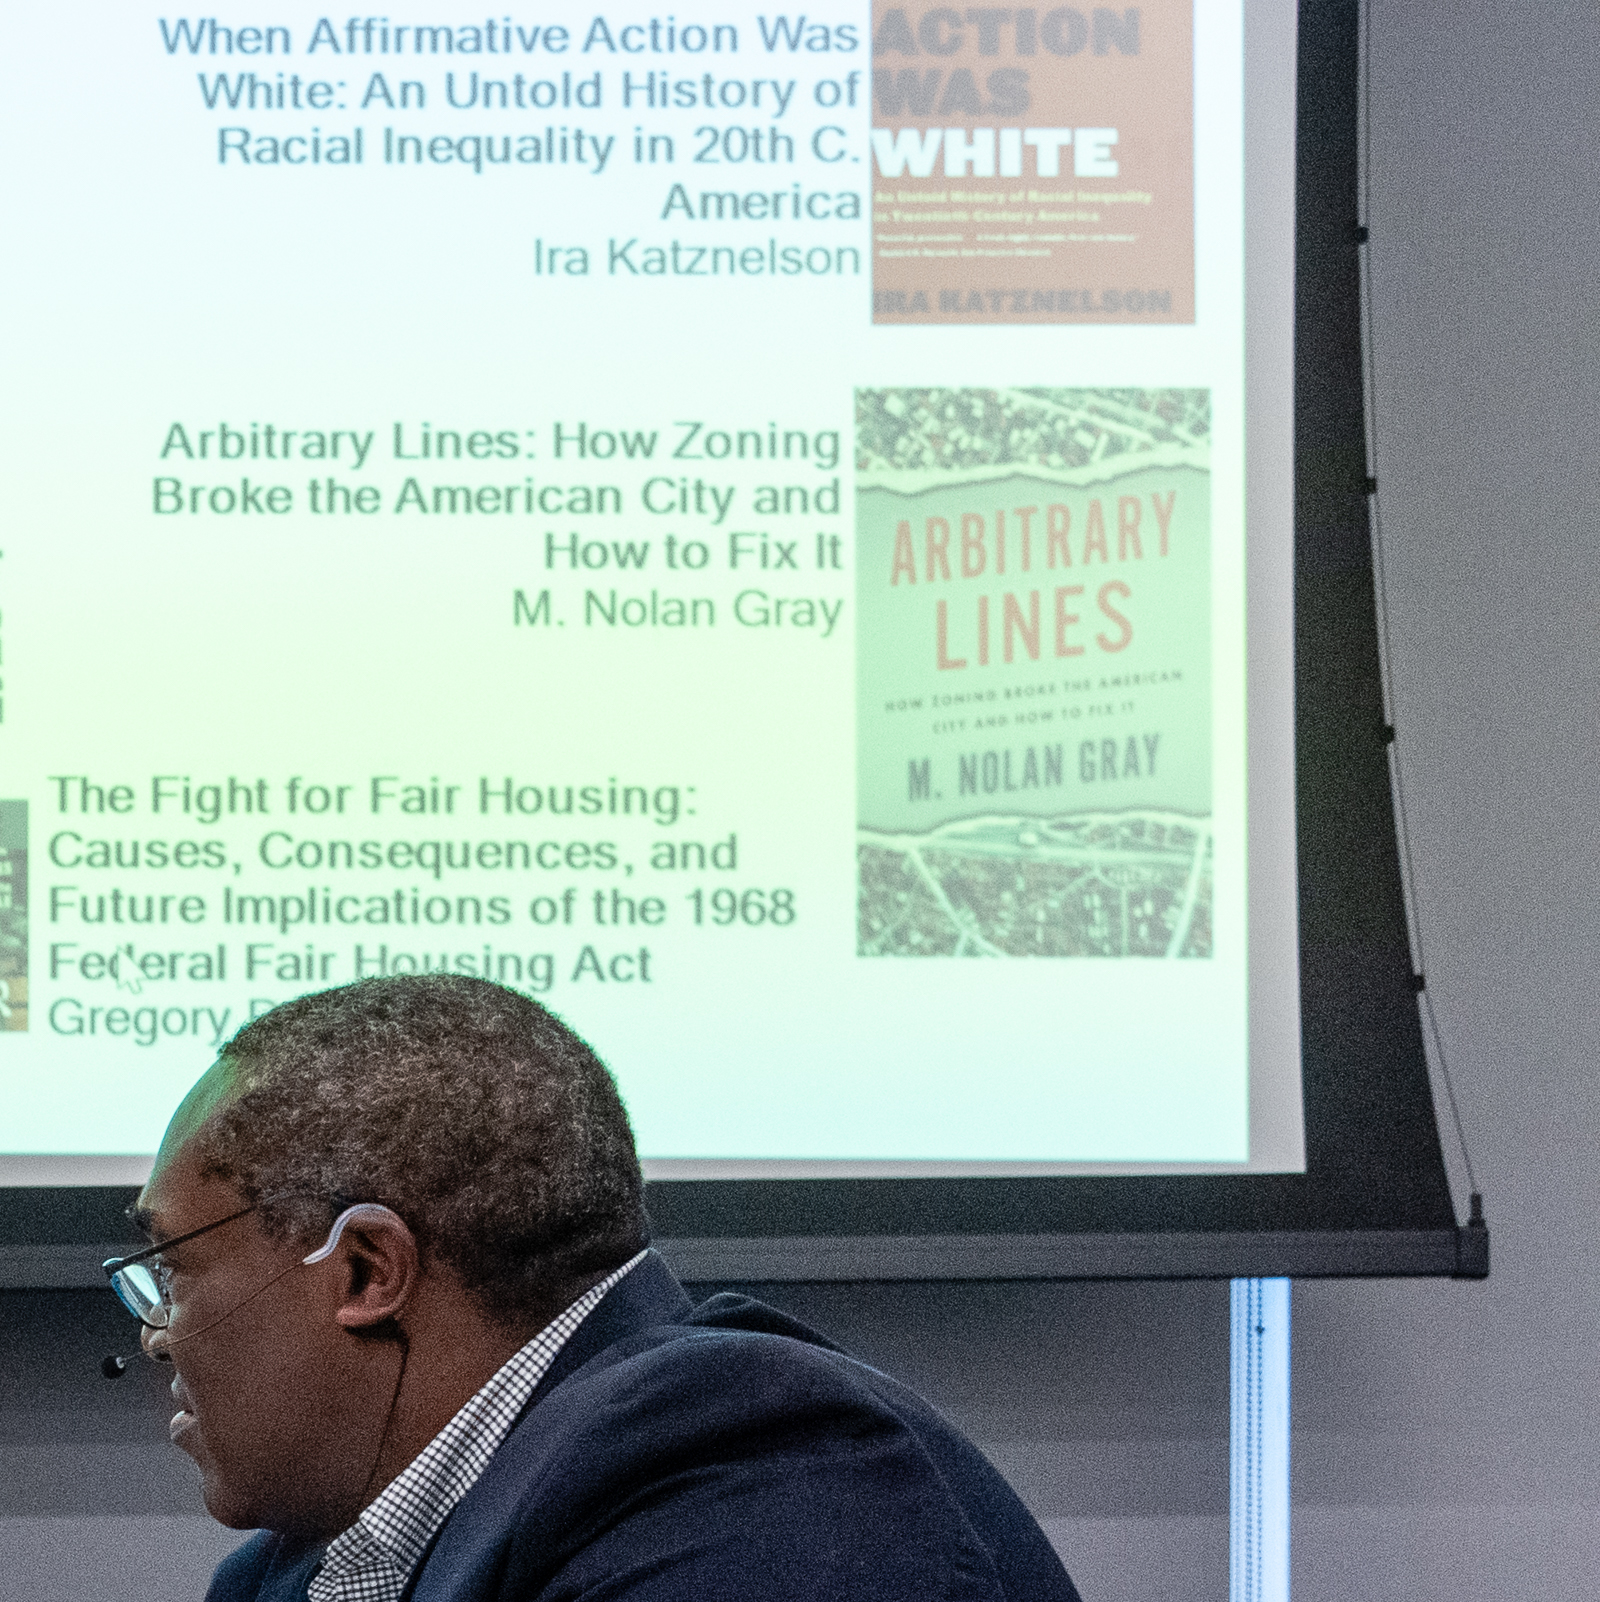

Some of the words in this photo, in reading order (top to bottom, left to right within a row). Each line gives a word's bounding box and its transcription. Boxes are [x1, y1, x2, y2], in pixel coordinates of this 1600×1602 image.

[158, 17, 291, 55] When
[307, 16, 570, 54] Affirmative
[582, 16, 738, 53] Action
[757, 15, 859, 52] Was
[876, 7, 1138, 58] ACTION
[197, 72, 345, 110] White:
[361, 72, 426, 109] An
[445, 71, 602, 109] Untold
[623, 71, 796, 117] History
[814, 71, 859, 107] of
[876, 67, 1029, 117] WAS
[218, 127, 364, 165] Racial
[384, 126, 615, 176] Inequality
[634, 126, 674, 163] in
[694, 126, 794, 163] 20th
[811, 126, 859, 162] C.
[873, 128, 1118, 177] WHITE
[874, 289, 930, 314] IRA
[939, 289, 1170, 313] KATZNELSON
[160, 422, 374, 470] Arbitrary
[393, 422, 534, 459] Lines:
[554, 422, 658, 459] How
[672, 421, 840, 470] Zoning
[153, 477, 293, 514] Broke
[308, 477, 381, 514] the
[394, 477, 622, 514] American
[641, 477, 735, 525] City
[753, 478, 840, 514] and
[890, 493, 1176, 588] ARBITRARY
[937, 580, 1134, 671] LINES
[907, 758, 943, 802] M.
[959, 744, 1063, 796] NOLAN
[1079, 733, 1162, 783] GRAY
[50, 776, 135, 814] The
[152, 776, 269, 824] Fight
[286, 776, 351, 814] for
[370, 776, 460, 814] Fair
[479, 777, 695, 826] Housing:
[48, 831, 242, 875] Causes,
[258, 831, 634, 880] Consequences,
[650, 833, 738, 870] and
[50, 885, 207, 924] Future
[224, 886, 512, 936] Implications
[529, 887, 576, 925] of
[593, 888, 667, 926] the
[688, 888, 797, 926] 1968
[246, 942, 336, 981] Fair
[354, 943, 555, 992] Housing
[571, 943, 653, 982] Act
